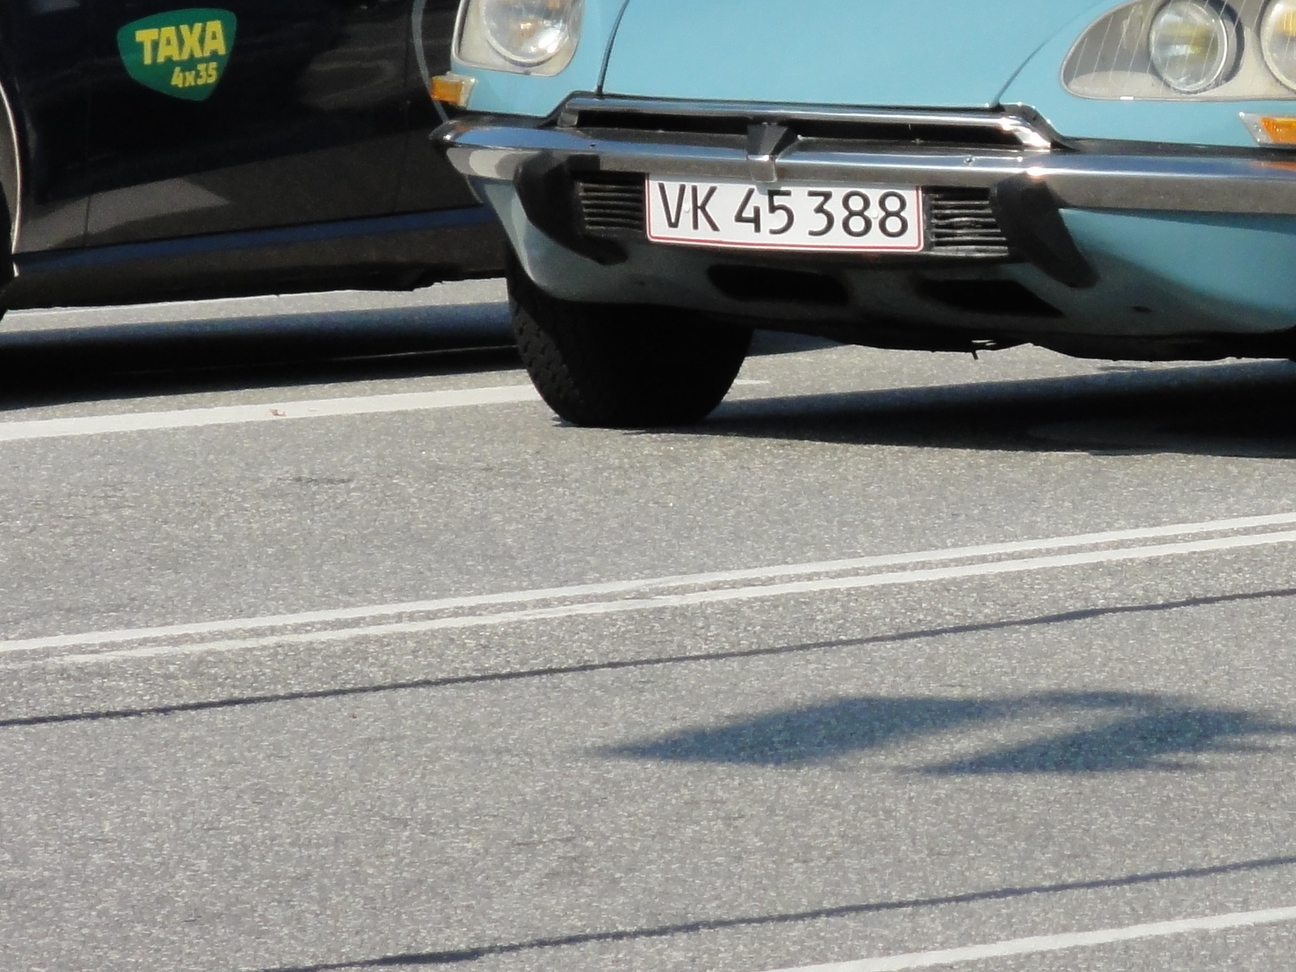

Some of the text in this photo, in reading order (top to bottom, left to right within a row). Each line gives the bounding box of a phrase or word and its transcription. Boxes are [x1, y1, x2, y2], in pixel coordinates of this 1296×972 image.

[135, 20, 226, 65] TAXA
[171, 61, 218, 87] 4x35
[658, 183, 909, 238] VK 45 388
